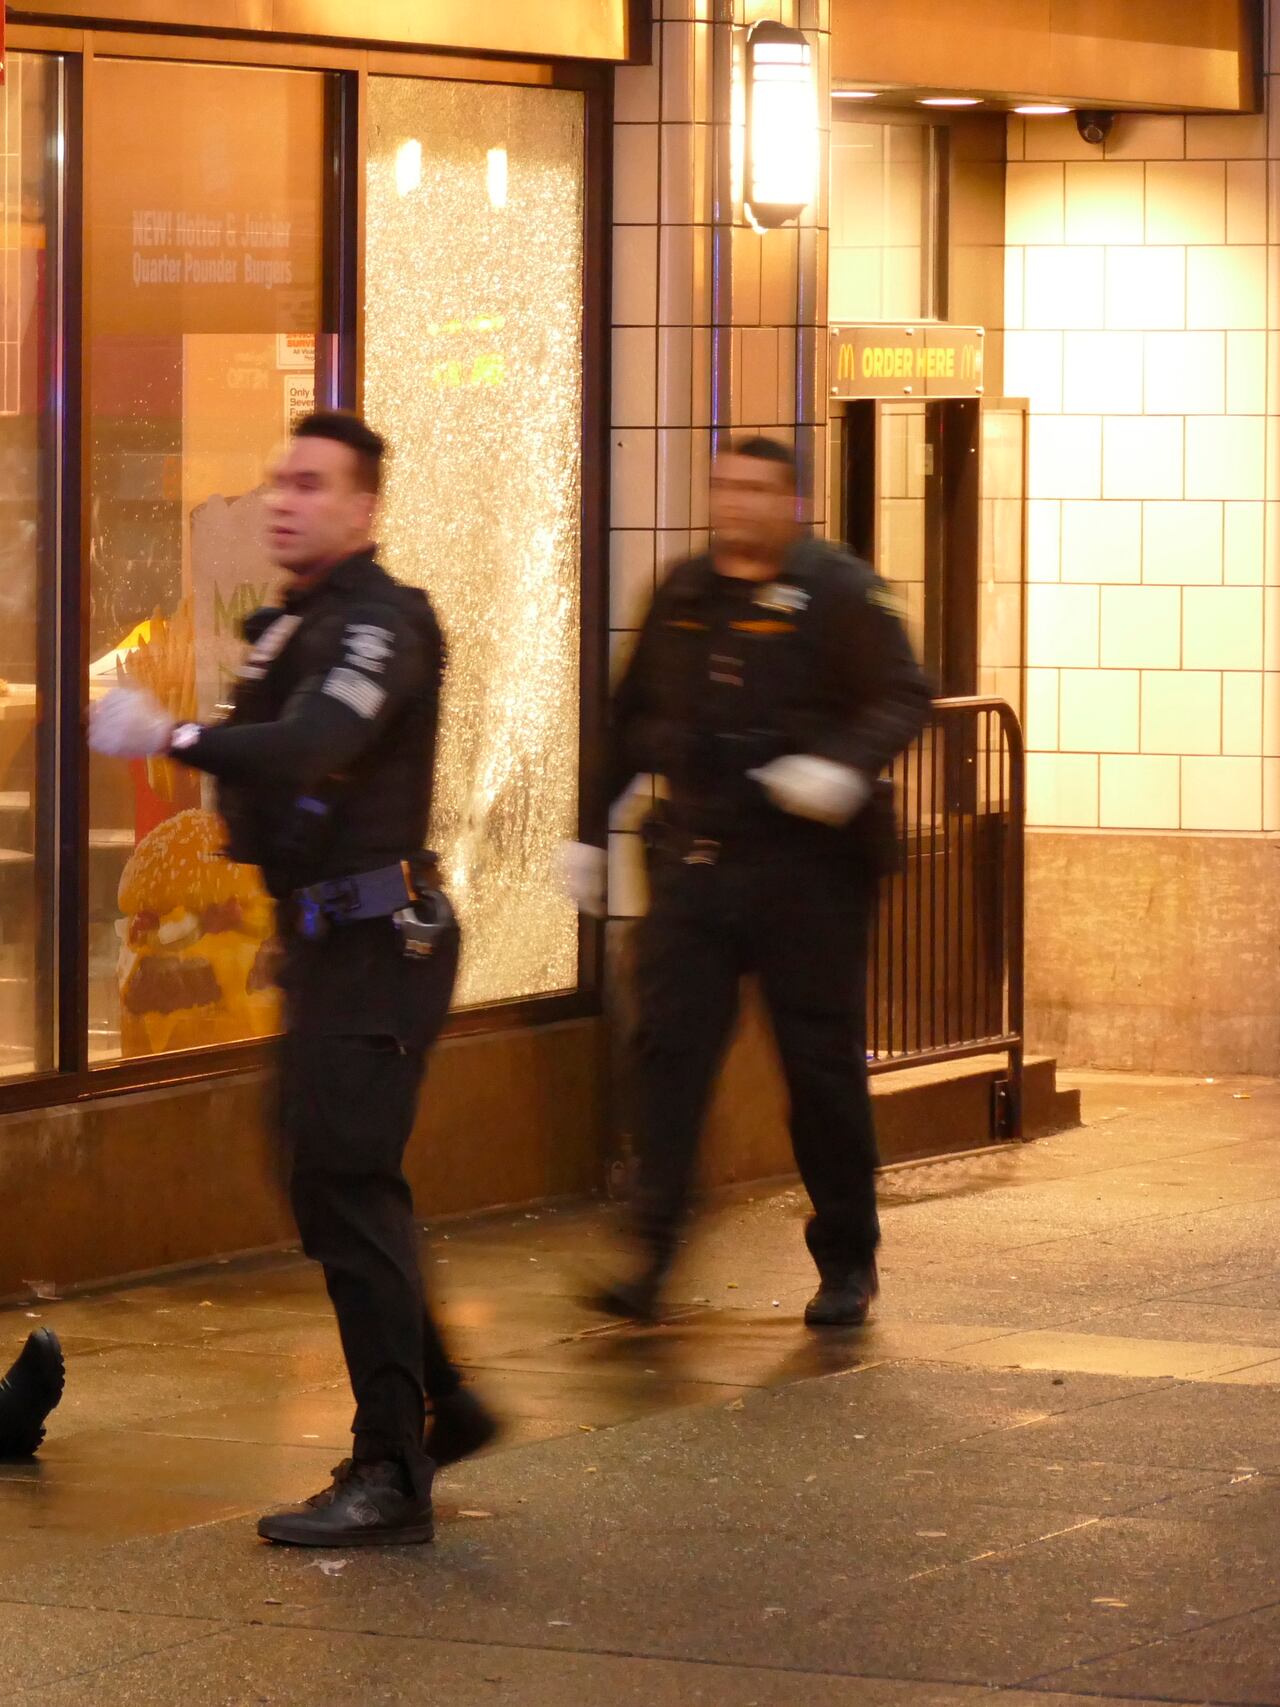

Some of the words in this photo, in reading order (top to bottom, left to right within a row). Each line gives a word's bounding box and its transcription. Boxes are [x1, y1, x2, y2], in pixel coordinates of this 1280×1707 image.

[132, 210, 172, 246] NEW!
[176, 211, 221, 247] Hotter
[241, 213, 291, 248] Juicier
[132, 251, 181, 287] Quarter
[184, 252, 237, 283] Pounder
[244, 252, 292, 289] Burgers
[862, 347, 913, 378] ORDER
[916, 347, 956, 378] HERE
[290, 388, 310, 399] Only
